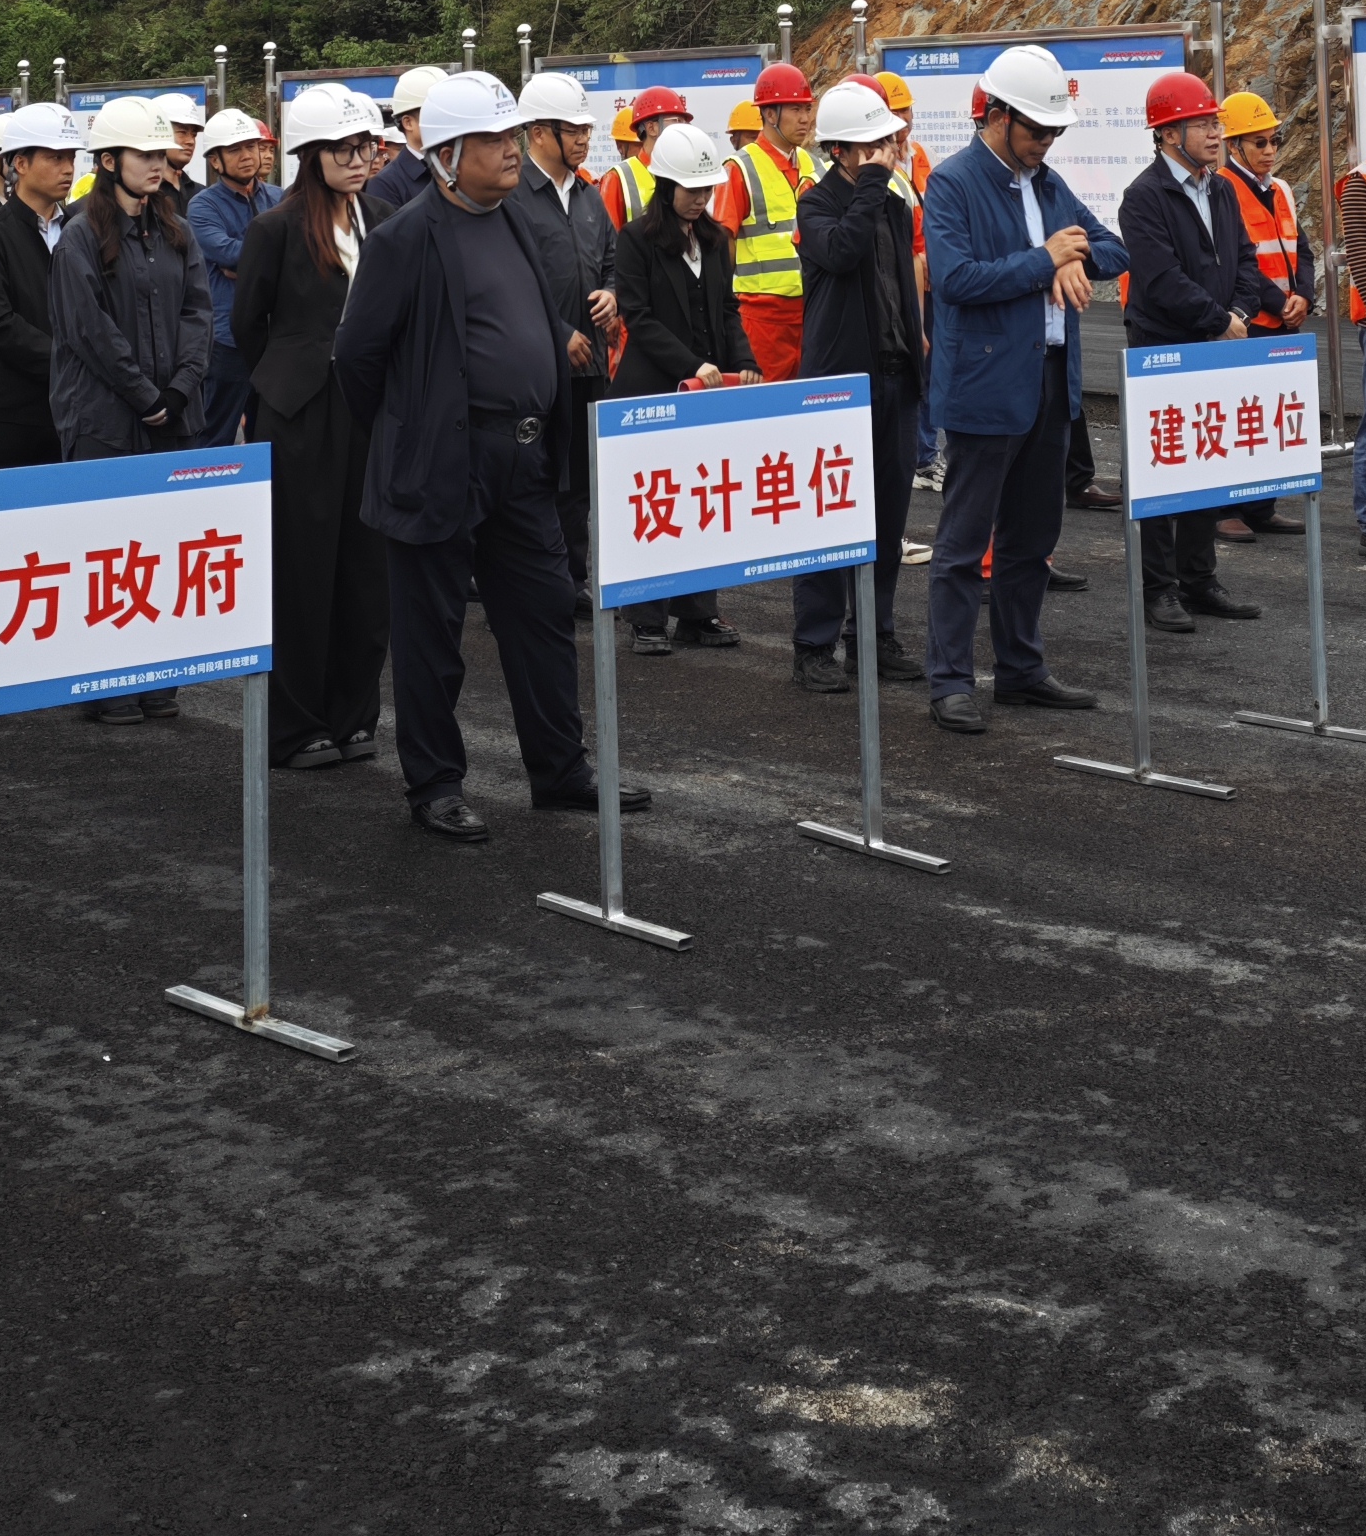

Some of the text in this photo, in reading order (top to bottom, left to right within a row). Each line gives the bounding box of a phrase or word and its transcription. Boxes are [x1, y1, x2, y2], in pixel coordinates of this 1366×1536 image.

[919, 52, 960, 65] 北新路橋
[635, 404, 677, 420] 北新路橋
[1150, 390, 1308, 468] 建设单位
[628, 443, 857, 544] 设计单位
[71, 654, 259, 695] 咸宁至崇阳高速公路XCTJ-1合同段项目经理部
